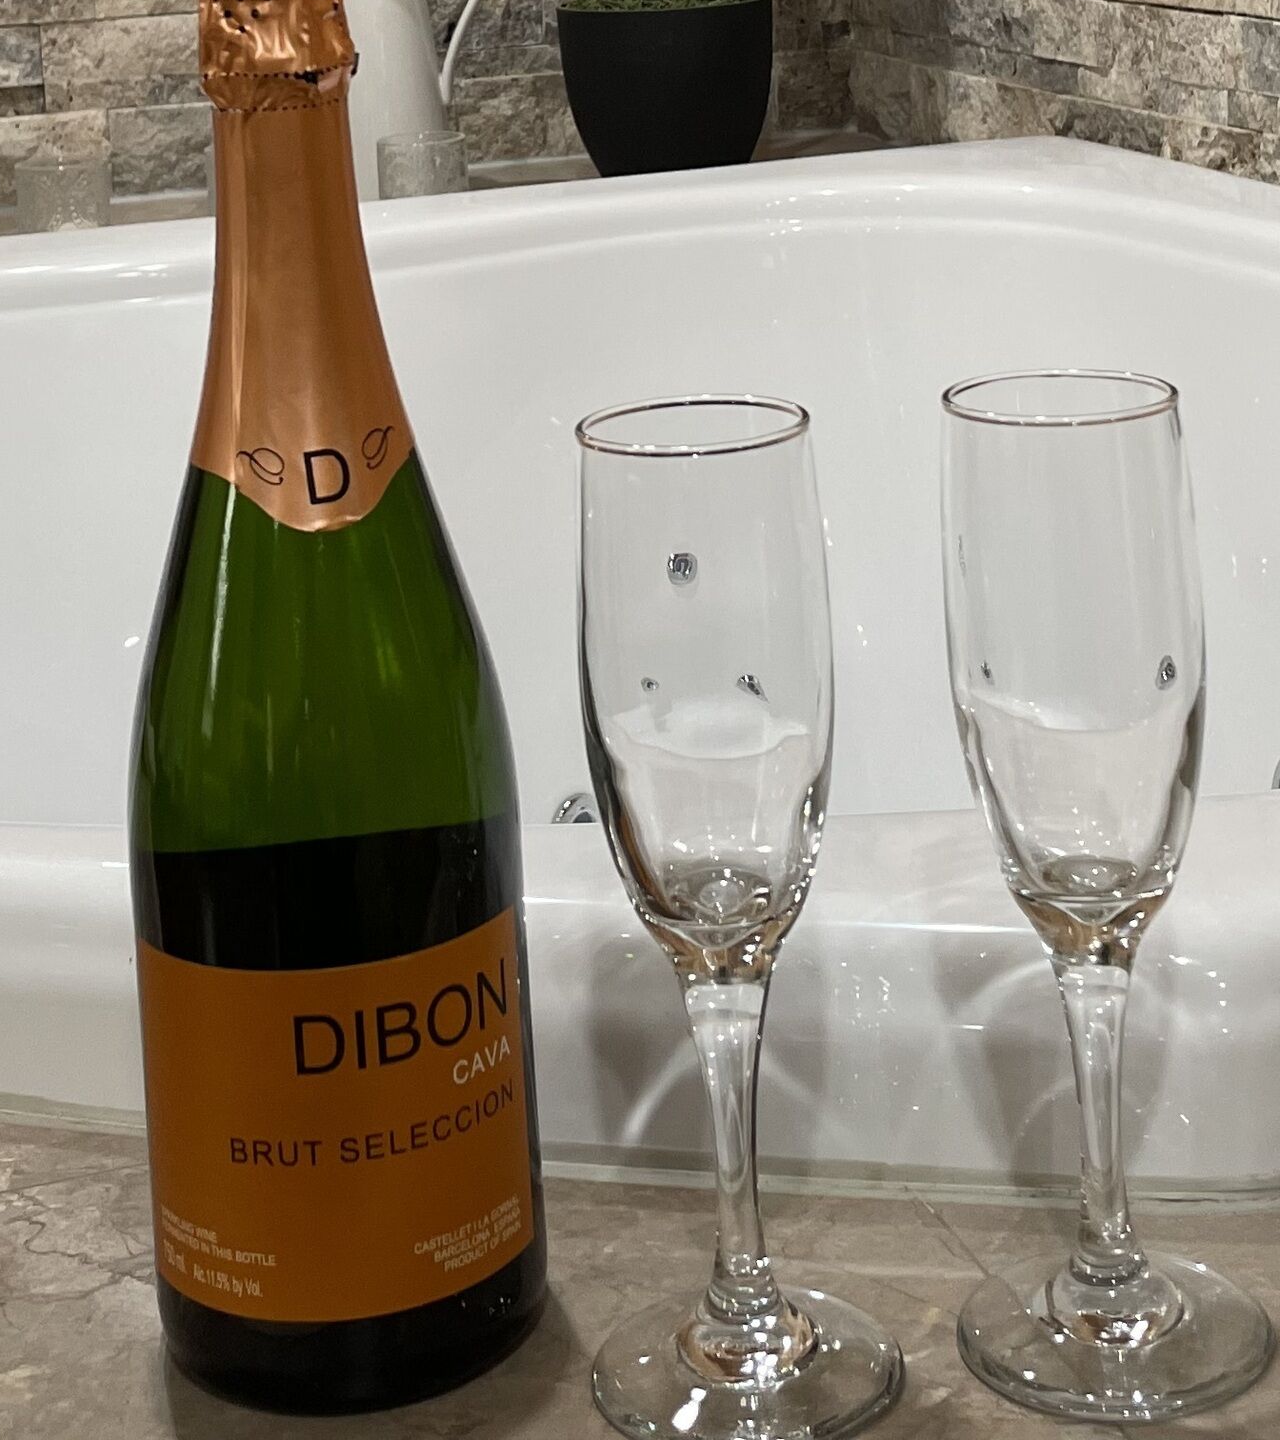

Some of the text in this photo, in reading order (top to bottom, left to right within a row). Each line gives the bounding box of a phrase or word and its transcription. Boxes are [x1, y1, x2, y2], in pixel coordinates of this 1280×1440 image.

[304, 448, 350, 505] D
[293, 958, 508, 1075] DIBON
[453, 1035, 511, 1085] CAVA
[230, 1079, 515, 1167] BRUT SELECCION
[211, 1244, 233, 1261] THIS
[235, 1250, 278, 1266] BOTTLE
[414, 1223, 471, 1254] CASTELLET
[478, 1214, 490, 1229] LA
[444, 1241, 488, 1273] PRODUCT
[232, 1275, 243, 1298] by
[245, 1277, 263, 1298] Vol.
